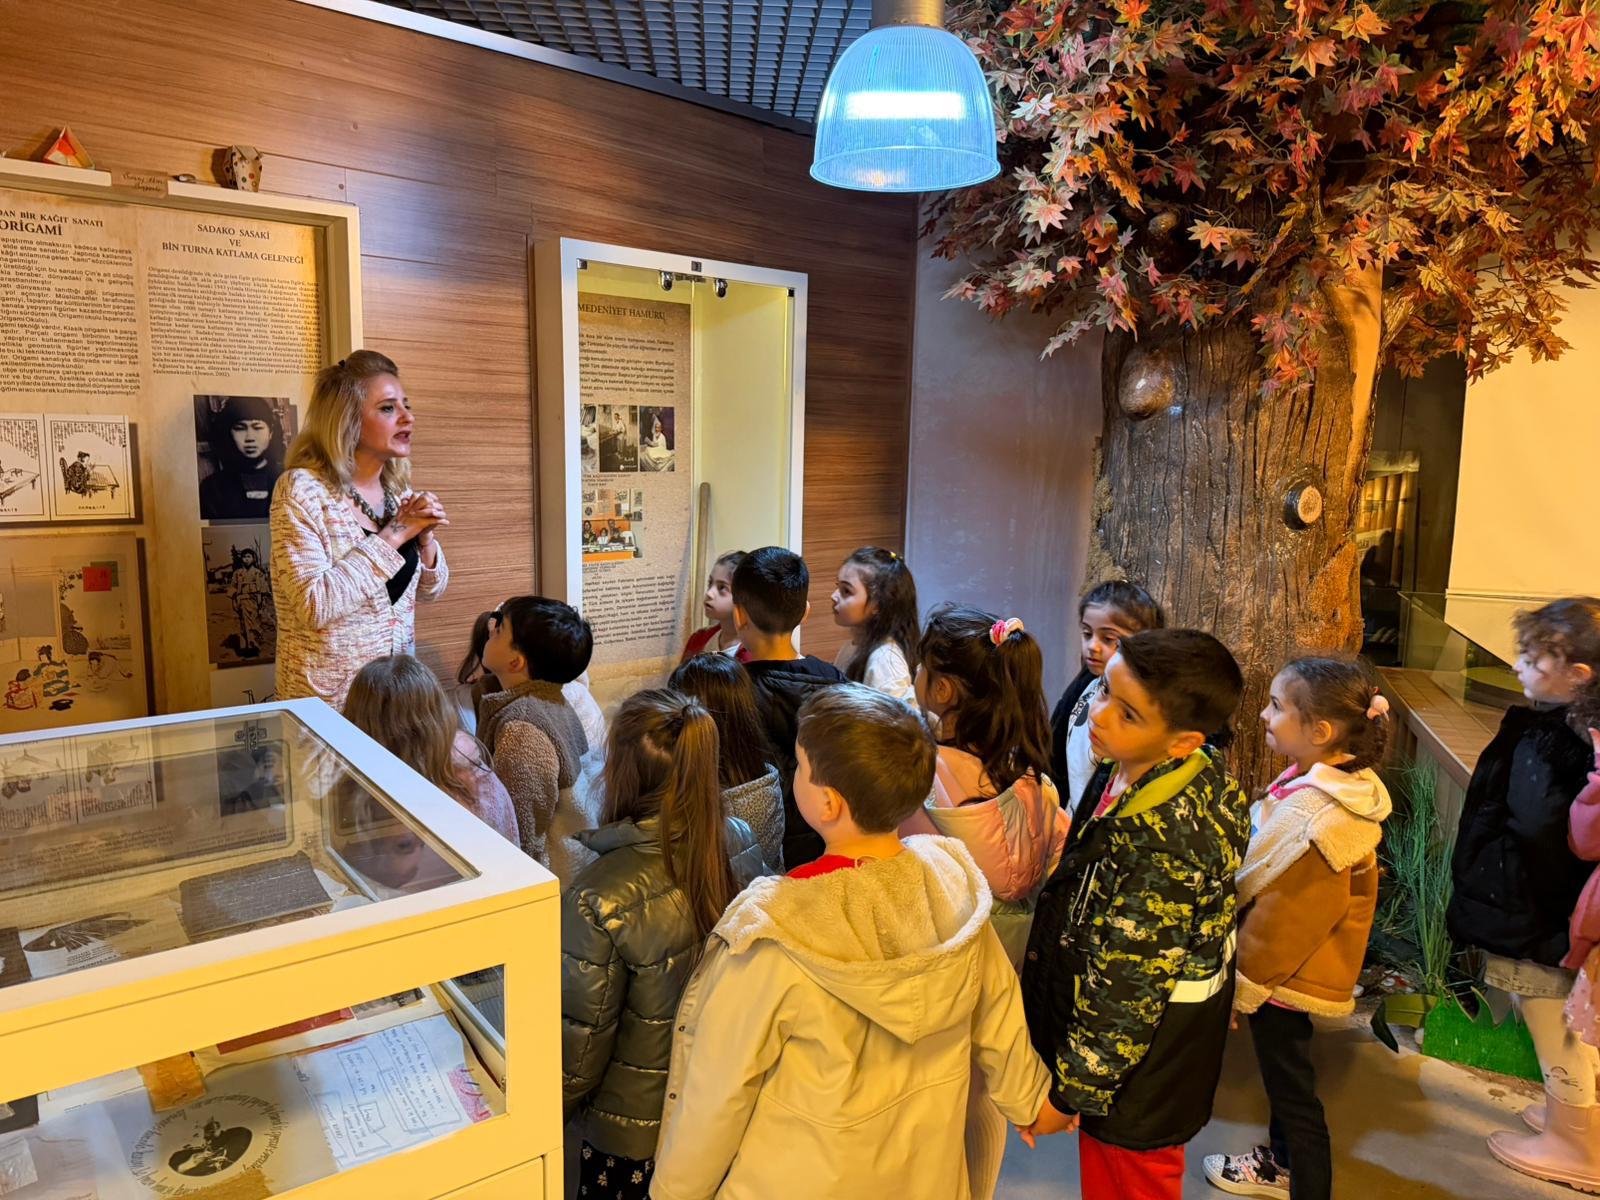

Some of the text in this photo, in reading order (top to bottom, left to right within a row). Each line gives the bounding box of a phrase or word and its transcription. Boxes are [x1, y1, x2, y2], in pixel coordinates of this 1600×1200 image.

[0, 219, 63, 236] ORİGAMİ
[20, 211, 36, 220] BİR
[40, 213, 69, 223] KAĞIT
[72, 218, 104, 228] SANATI
[197, 223, 271, 240] SADAKO SASAKİ
[229, 239, 242, 247] VE
[162, 241, 304, 265] BİN TURNA KATLAMA GELENEĞİ
[578, 303, 627, 316] MEDENİYET
